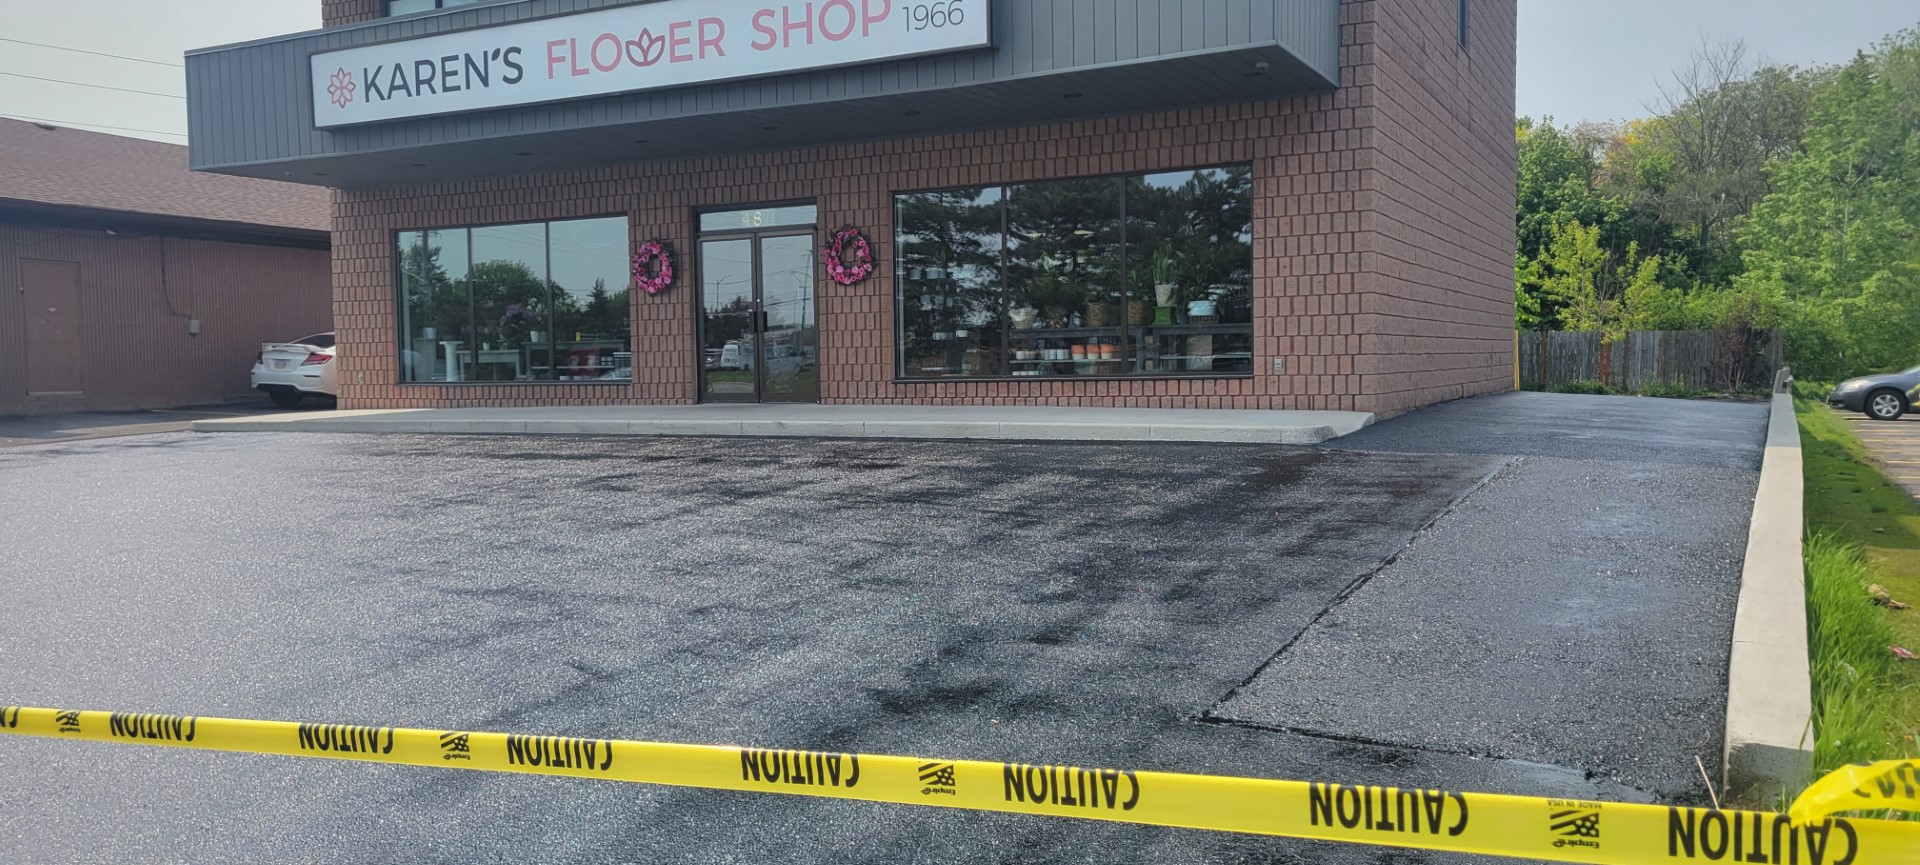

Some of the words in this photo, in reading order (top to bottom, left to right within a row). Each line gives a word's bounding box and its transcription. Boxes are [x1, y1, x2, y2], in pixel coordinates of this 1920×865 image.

[902, 0, 965, 32] 1966
[363, 46, 524, 103] KAREN'S
[750, 0, 891, 51] SHOP
[298, 722, 394, 755] CAUTION
[506, 735, 613, 771] CAUTION
[740, 749, 860, 788] CAUTION
[1003, 763, 1140, 811] CAUTION
[1309, 783, 1469, 837] CAUTION
[1668, 807, 1858, 865] CAUTION
